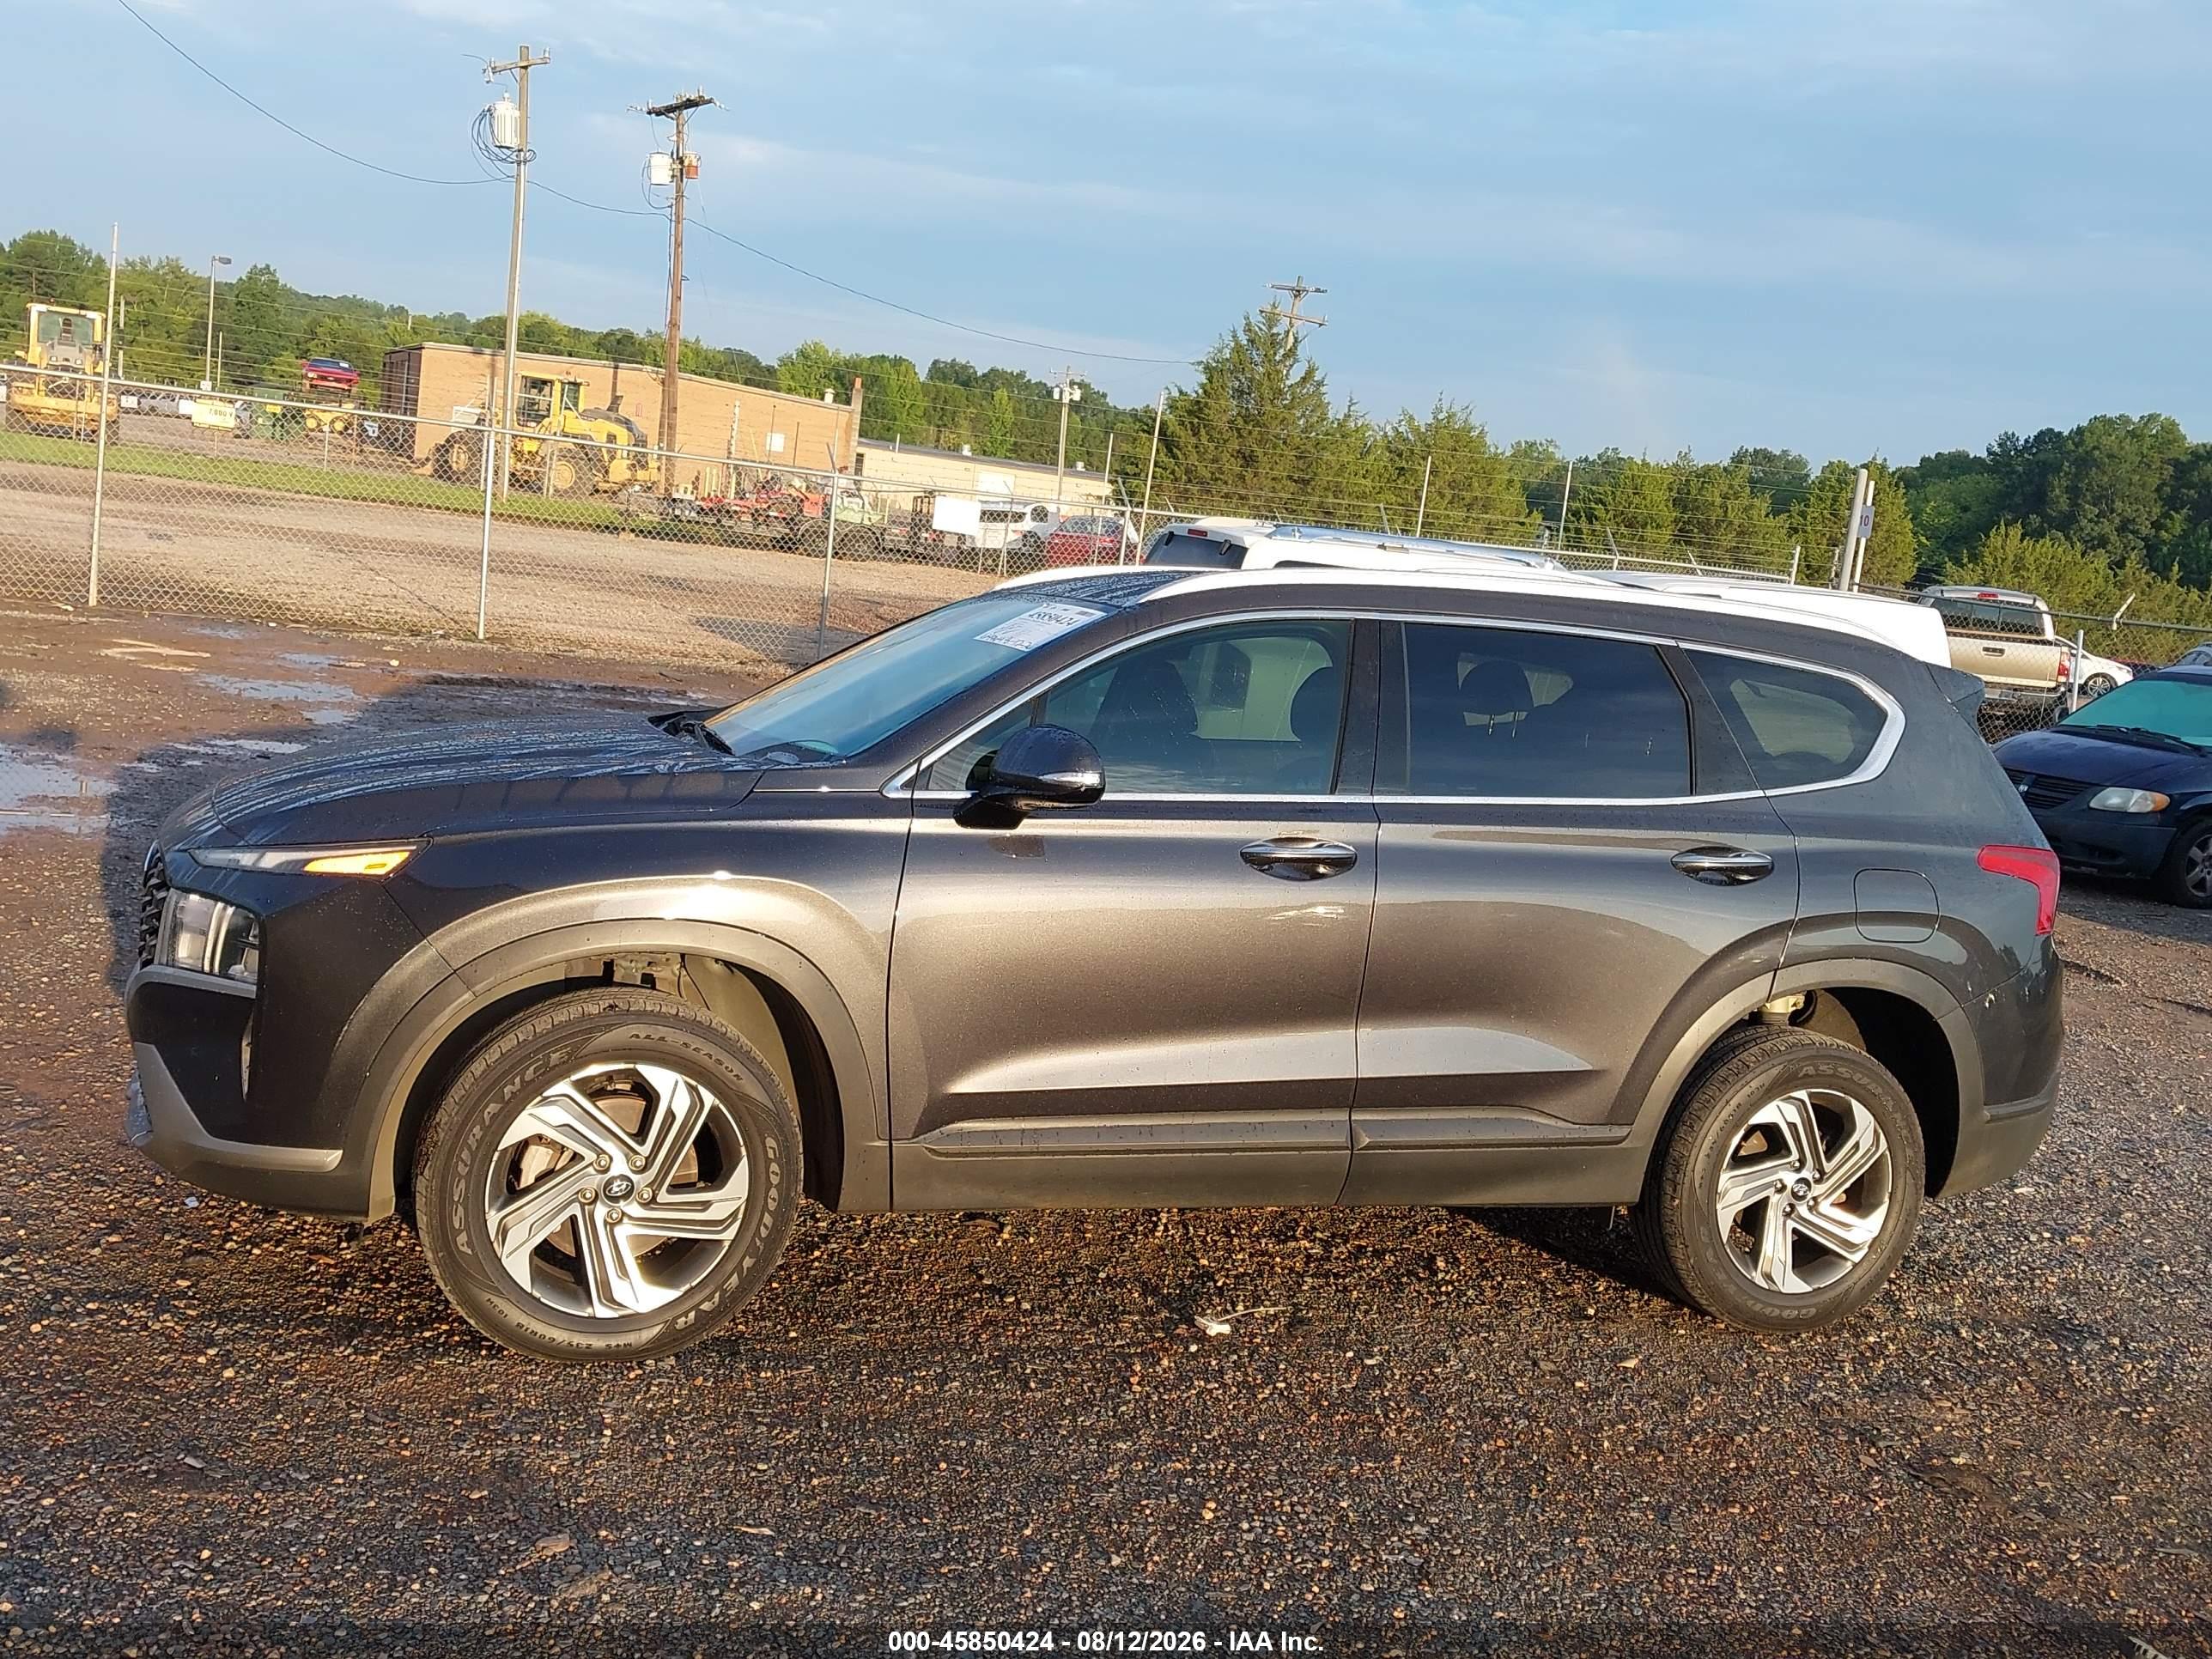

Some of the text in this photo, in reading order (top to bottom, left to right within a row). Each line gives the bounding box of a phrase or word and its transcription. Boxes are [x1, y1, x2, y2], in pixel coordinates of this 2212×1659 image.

[629, 1033, 744, 1081] ALL-SEASON
[452, 1047, 572, 1255] ASSURANCE
[674, 1136, 781, 1330] GOODYEAR
[485, 1297, 509, 1320] 103H
[514, 1322, 594, 1351] 235/60R18
